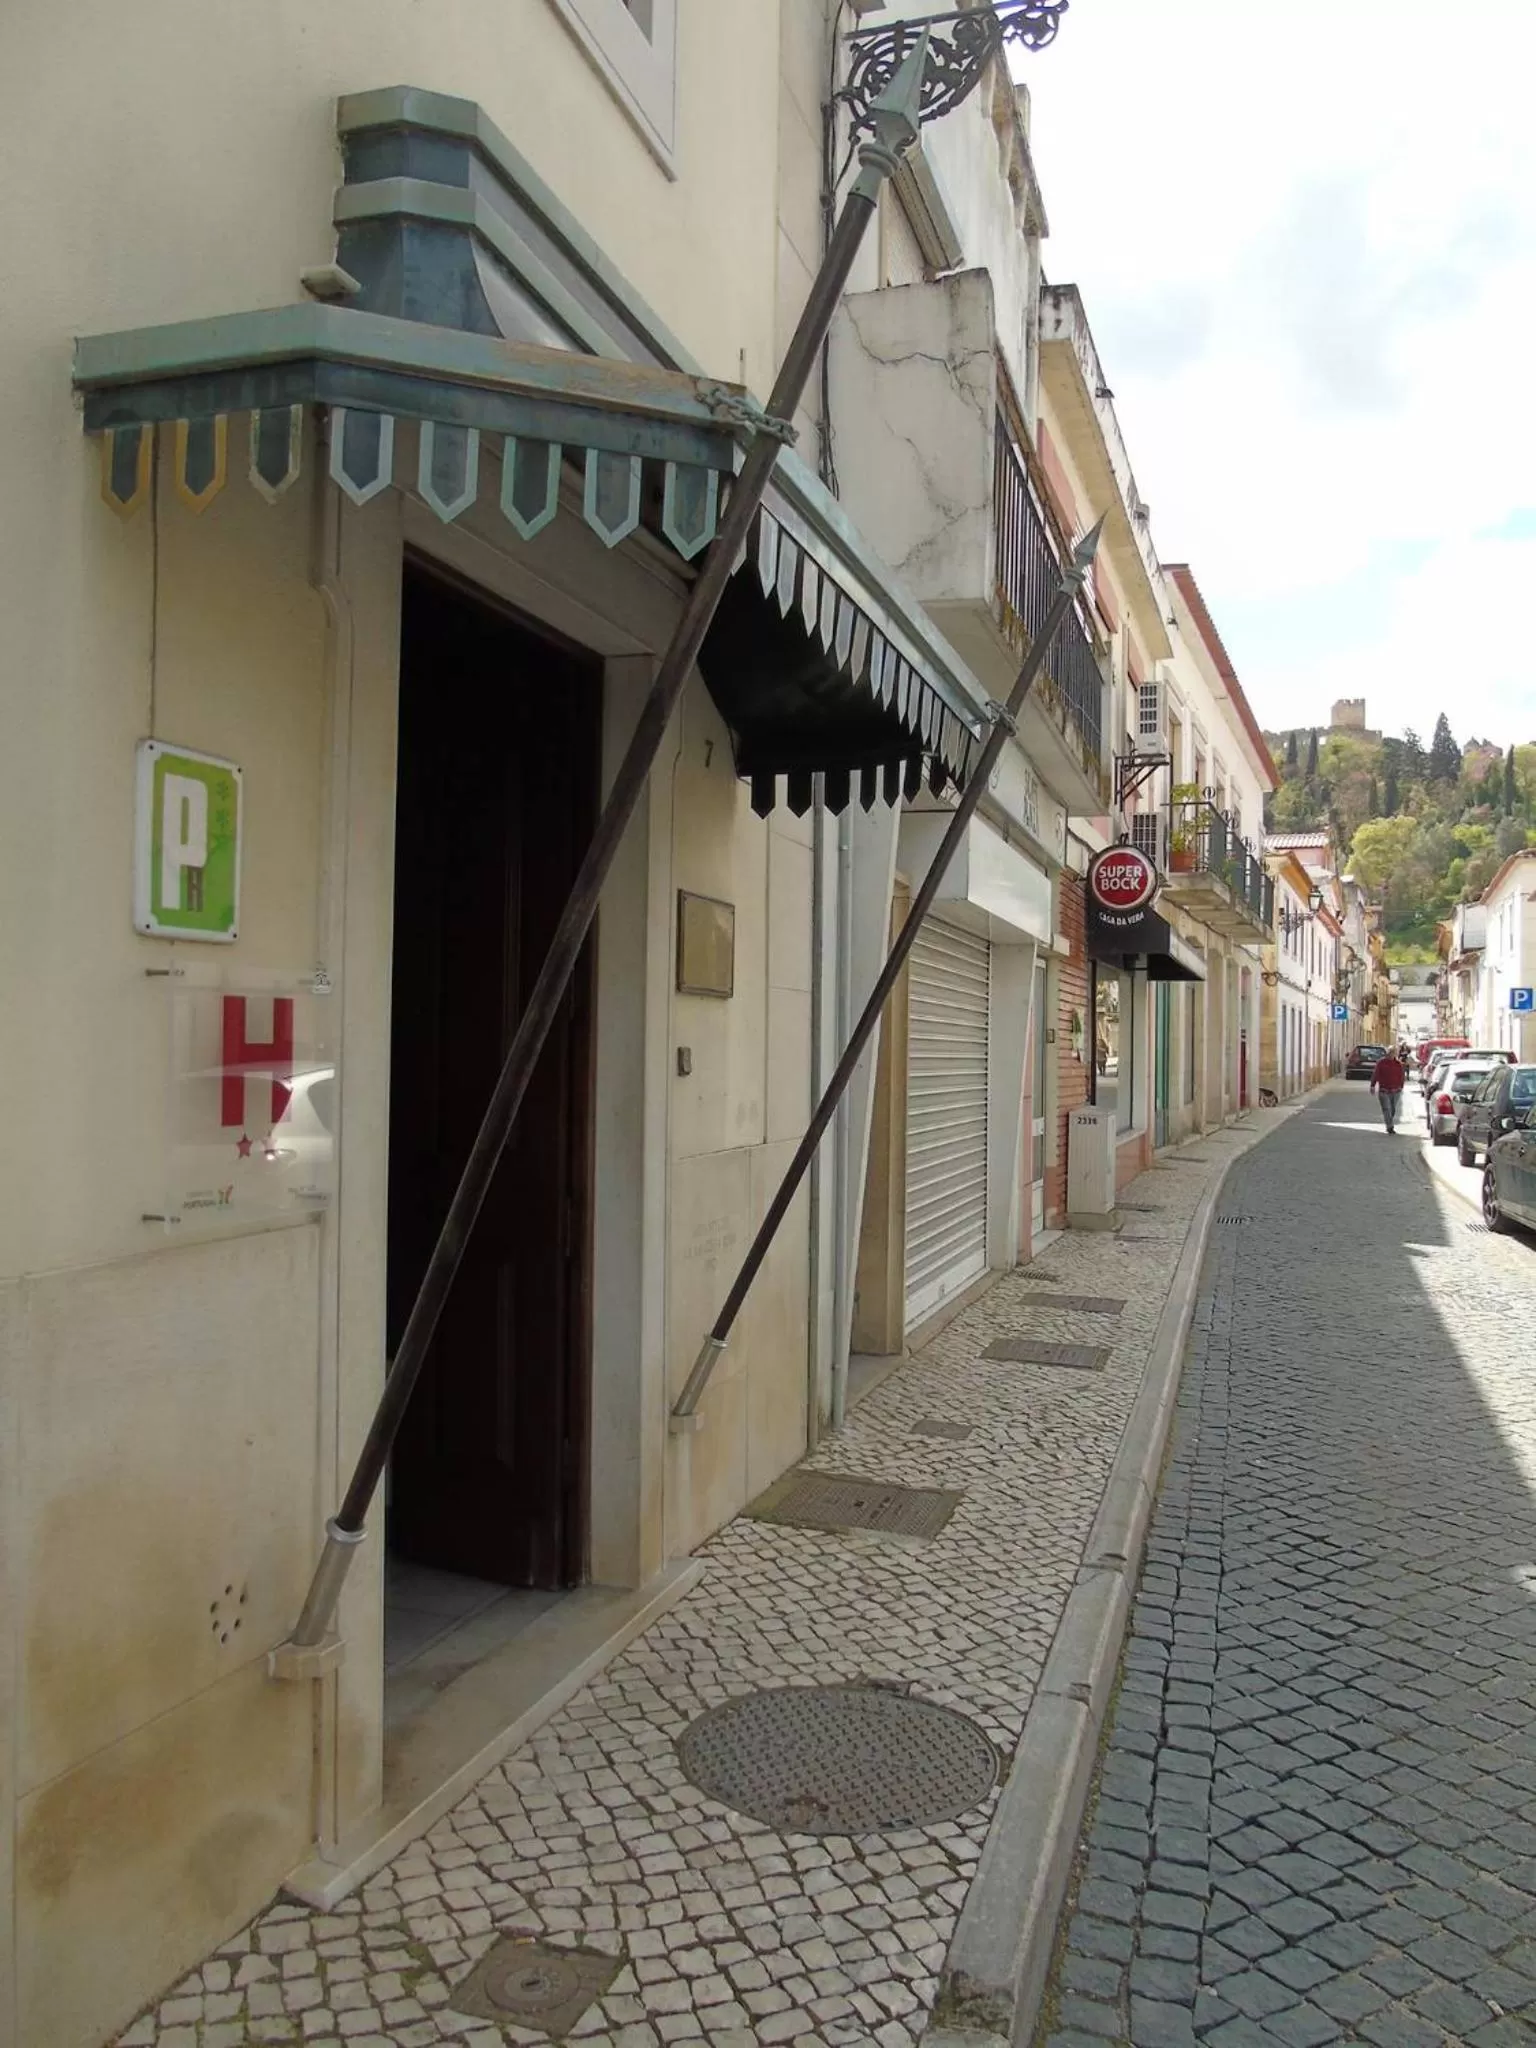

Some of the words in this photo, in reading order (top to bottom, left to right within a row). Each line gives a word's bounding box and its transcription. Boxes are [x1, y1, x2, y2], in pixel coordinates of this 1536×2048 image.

[161, 772, 208, 910] P
[1099, 865, 1143, 879] SUPER
[1101, 877, 1141, 891] BOCK
[1514, 990, 1528, 1007] P
[1334, 1005, 1345, 1019] P
[221, 995, 294, 1126] H
